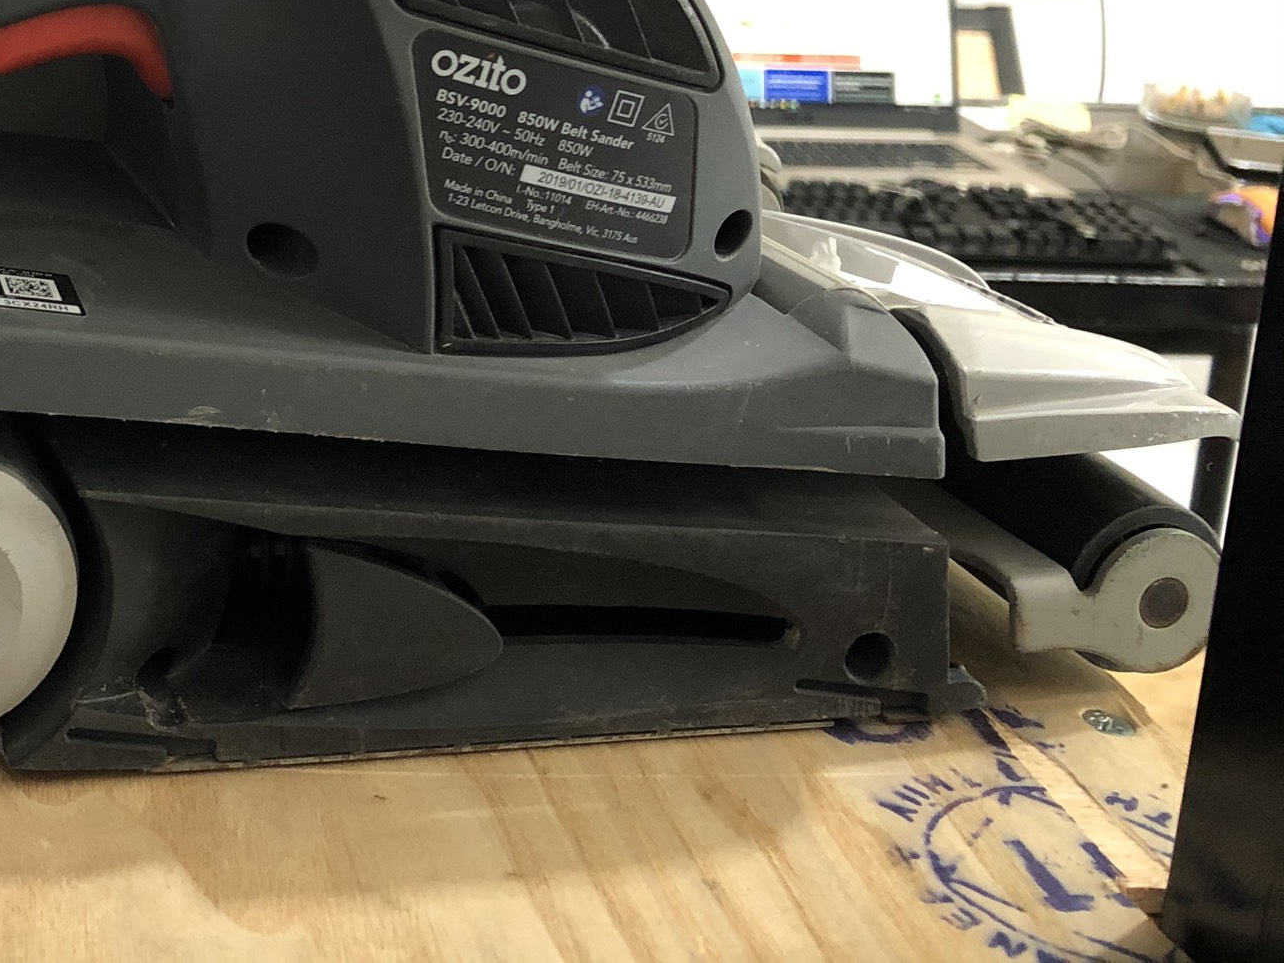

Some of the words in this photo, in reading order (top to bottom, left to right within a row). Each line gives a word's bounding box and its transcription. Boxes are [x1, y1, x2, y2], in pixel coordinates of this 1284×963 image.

[436, 88, 507, 118] BSV-9000
[517, 111, 560, 132] 850W
[561, 122, 589, 139] Belt
[591, 130, 634, 150] Sander
[437, 108, 500, 135] 230-240V
[514, 127, 545, 147] 50Hz
[558, 140, 594, 158] 850W
[441, 147, 473, 166] Date
[485, 157, 516, 176] O/N:
[461, 133, 548, 166] 300-400m/min
[558, 158, 582, 175] Belt
[584, 164, 608, 180] Size:
[612, 170, 625, 183] 75
[635, 176, 672, 192] 533mm
[444, 179, 472, 195] Made
[473, 186, 483, 196] in
[485, 189, 513, 204] China
[526, 198, 548, 214] Type
[447, 193, 469, 207] 1-23
[602, 228, 623, 241] 3175
